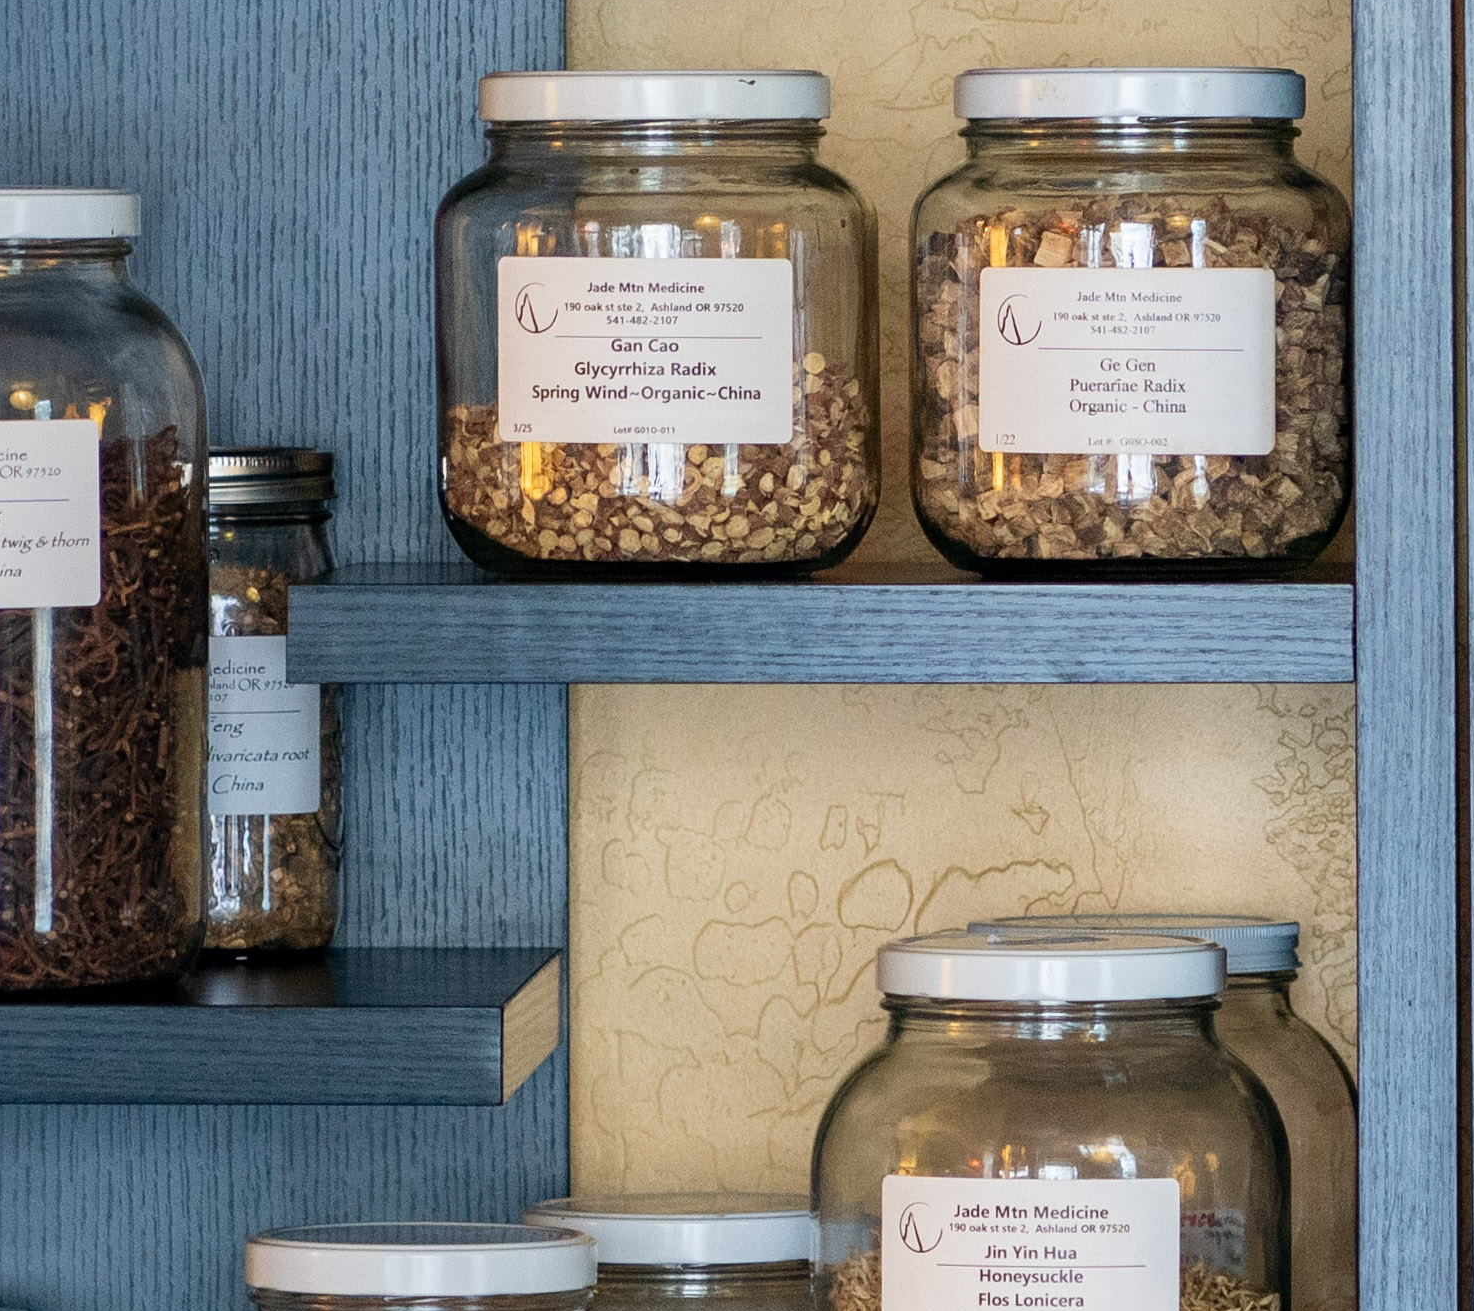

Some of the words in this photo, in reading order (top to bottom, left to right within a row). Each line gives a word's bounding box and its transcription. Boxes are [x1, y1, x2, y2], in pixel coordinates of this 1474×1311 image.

[565, 302, 581, 311] 190
[584, 303, 602, 311] oak
[651, 303, 692, 312] Ashland
[696, 303, 710, 312] OR
[714, 303, 744, 312] 97520
[611, 338, 642, 352] Gan
[648, 338, 679, 352] Cao
[575, 361, 664, 379] Glycyrrhiza
[671, 362, 716, 376] Radix
[1100, 359, 1120, 371] Ge
[1126, 359, 1155, 372] Gen
[985, 1245, 1007, 1258] Jin
[1013, 1246, 1038, 1259] Yin
[1044, 1247, 1077, 1259] Hua
[980, 1268, 1083, 1286] Honeysuckle
